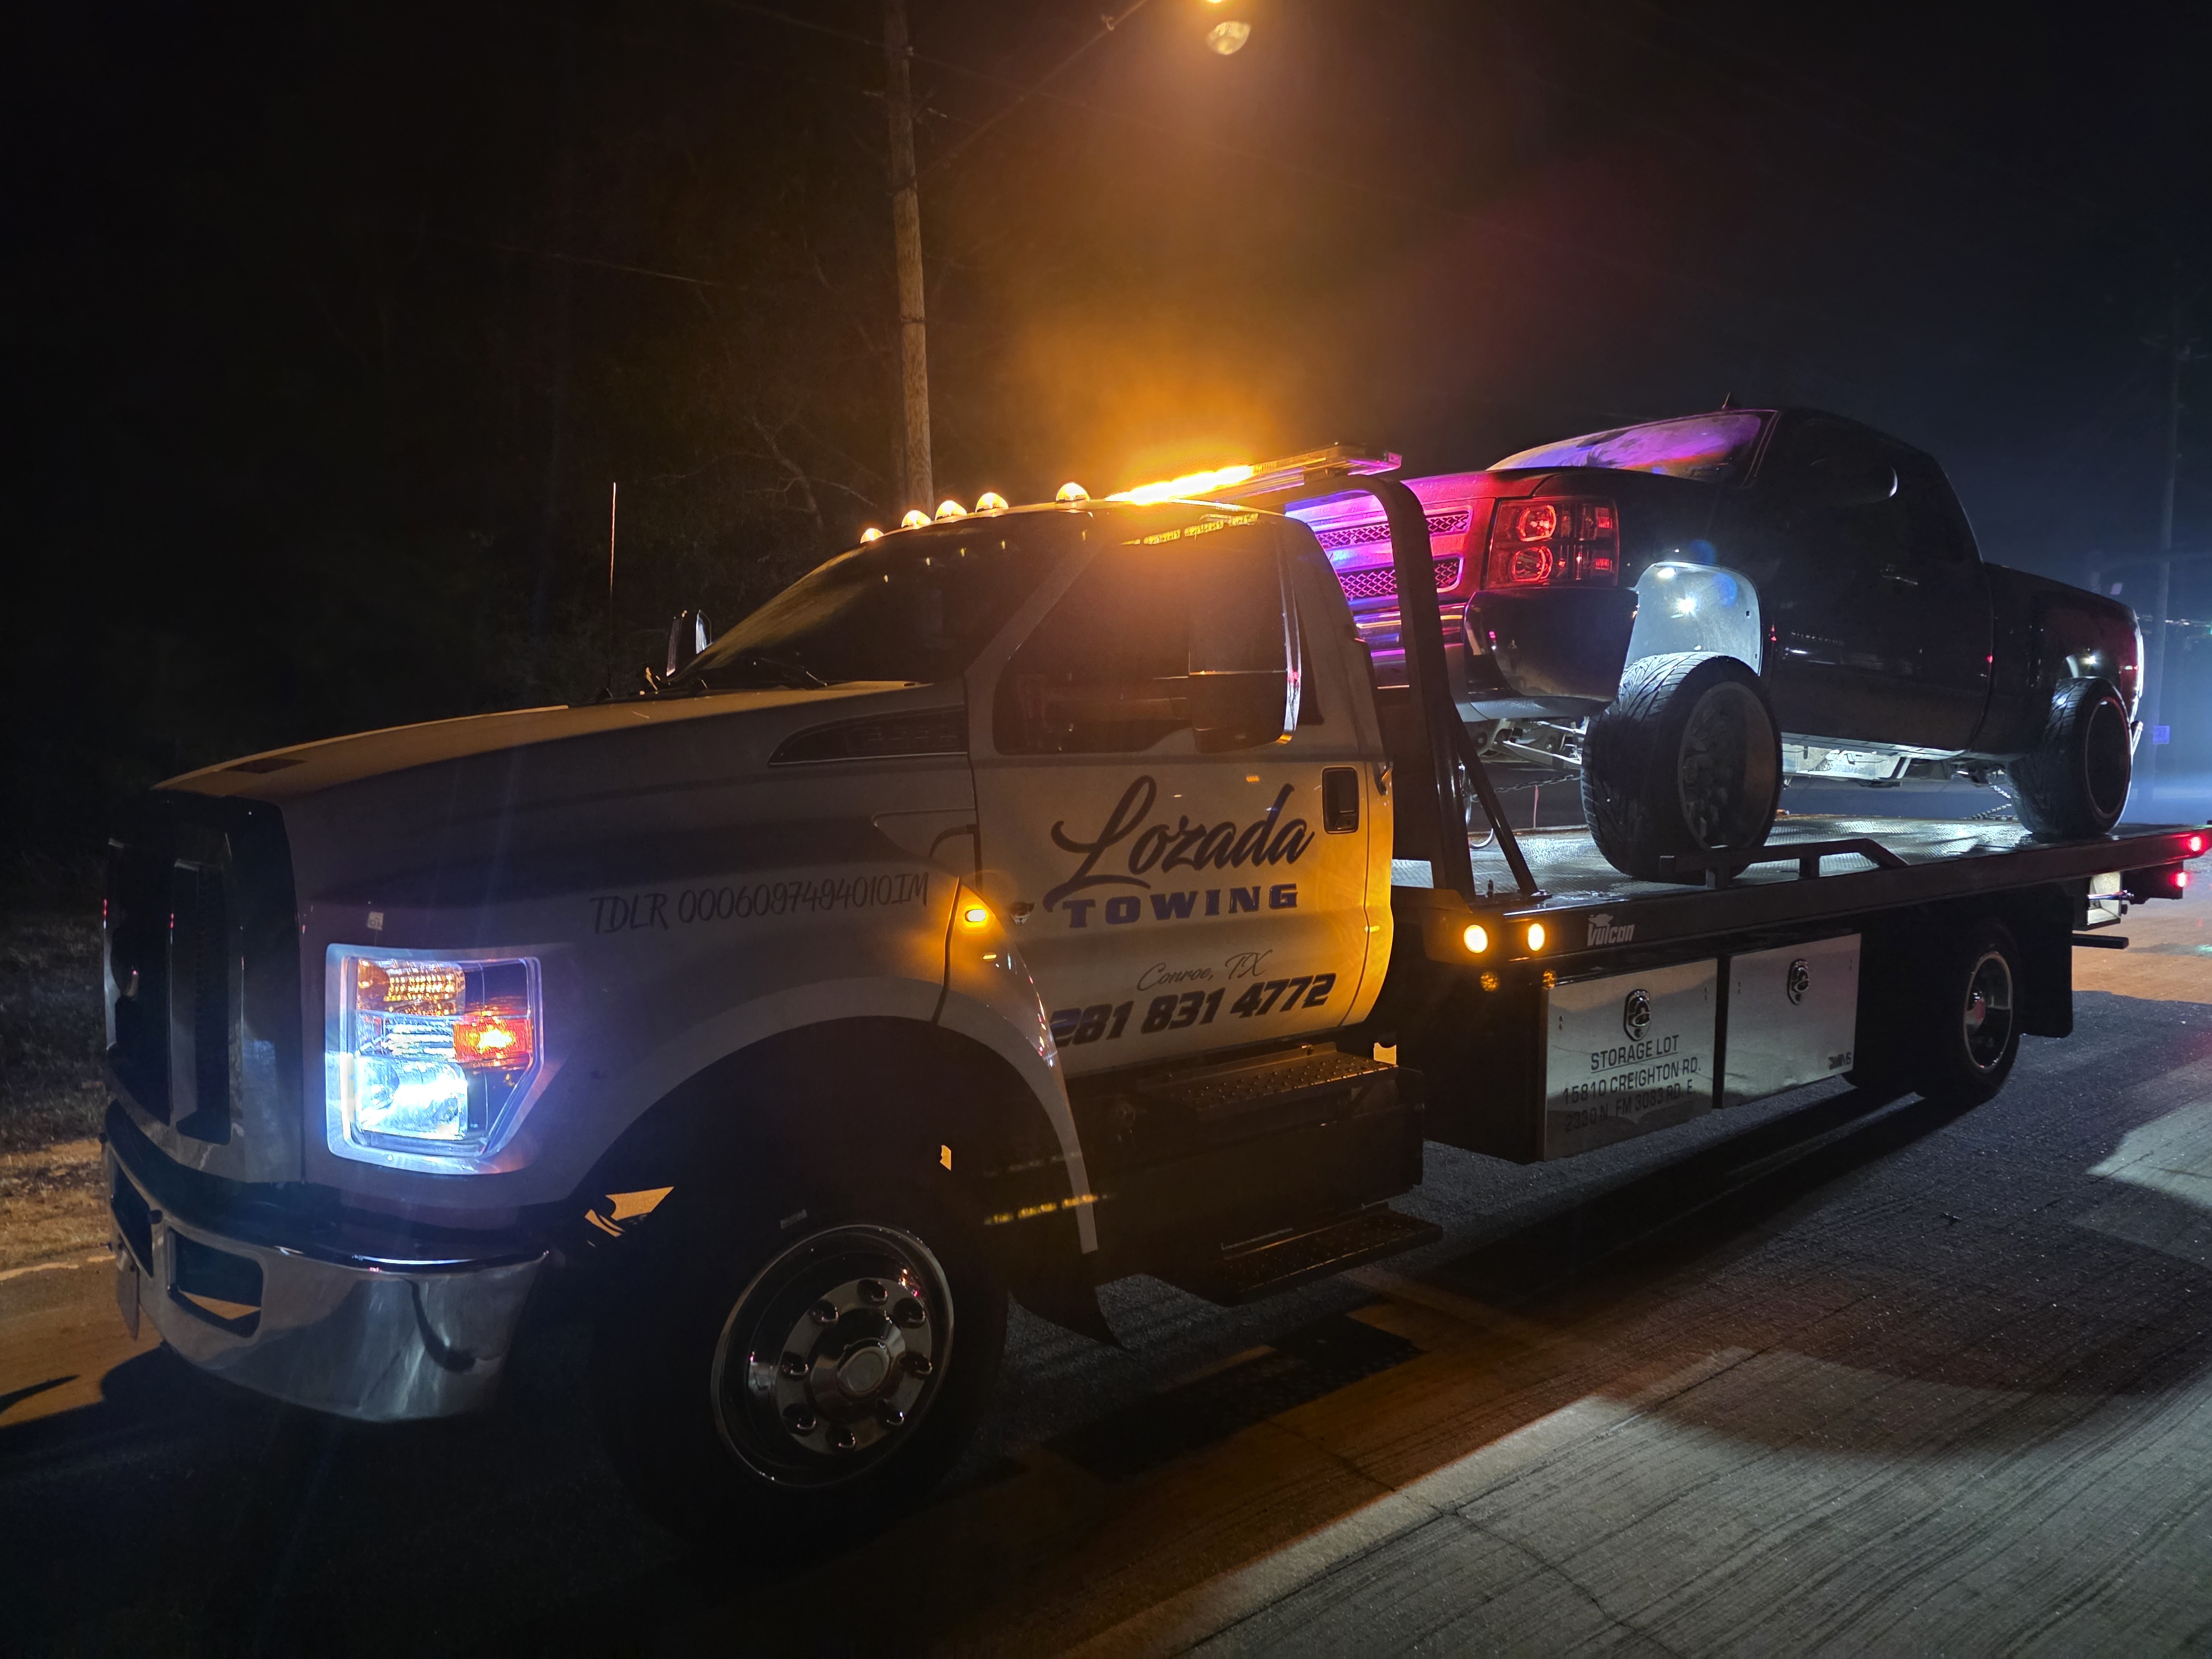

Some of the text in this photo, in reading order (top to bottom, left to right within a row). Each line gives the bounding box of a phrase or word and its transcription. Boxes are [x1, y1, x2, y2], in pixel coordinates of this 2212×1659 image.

[1043, 775, 1314, 912] Lozada
[589, 893, 669, 934] TDLR
[1062, 884, 1298, 928] TOWING
[1137, 950, 1272, 992] Conroe, TX
[1051, 973, 1337, 1047] 281 831 4772
[1591, 1034, 1679, 1071] STORAGE LOT
[1563, 1057, 1701, 1105] 15810 CREIGHTON RD.
[1600, 1103, 1609, 1121] N
[1616, 1098, 1631, 1117] FM
[1635, 1087, 1664, 1112] 3083
